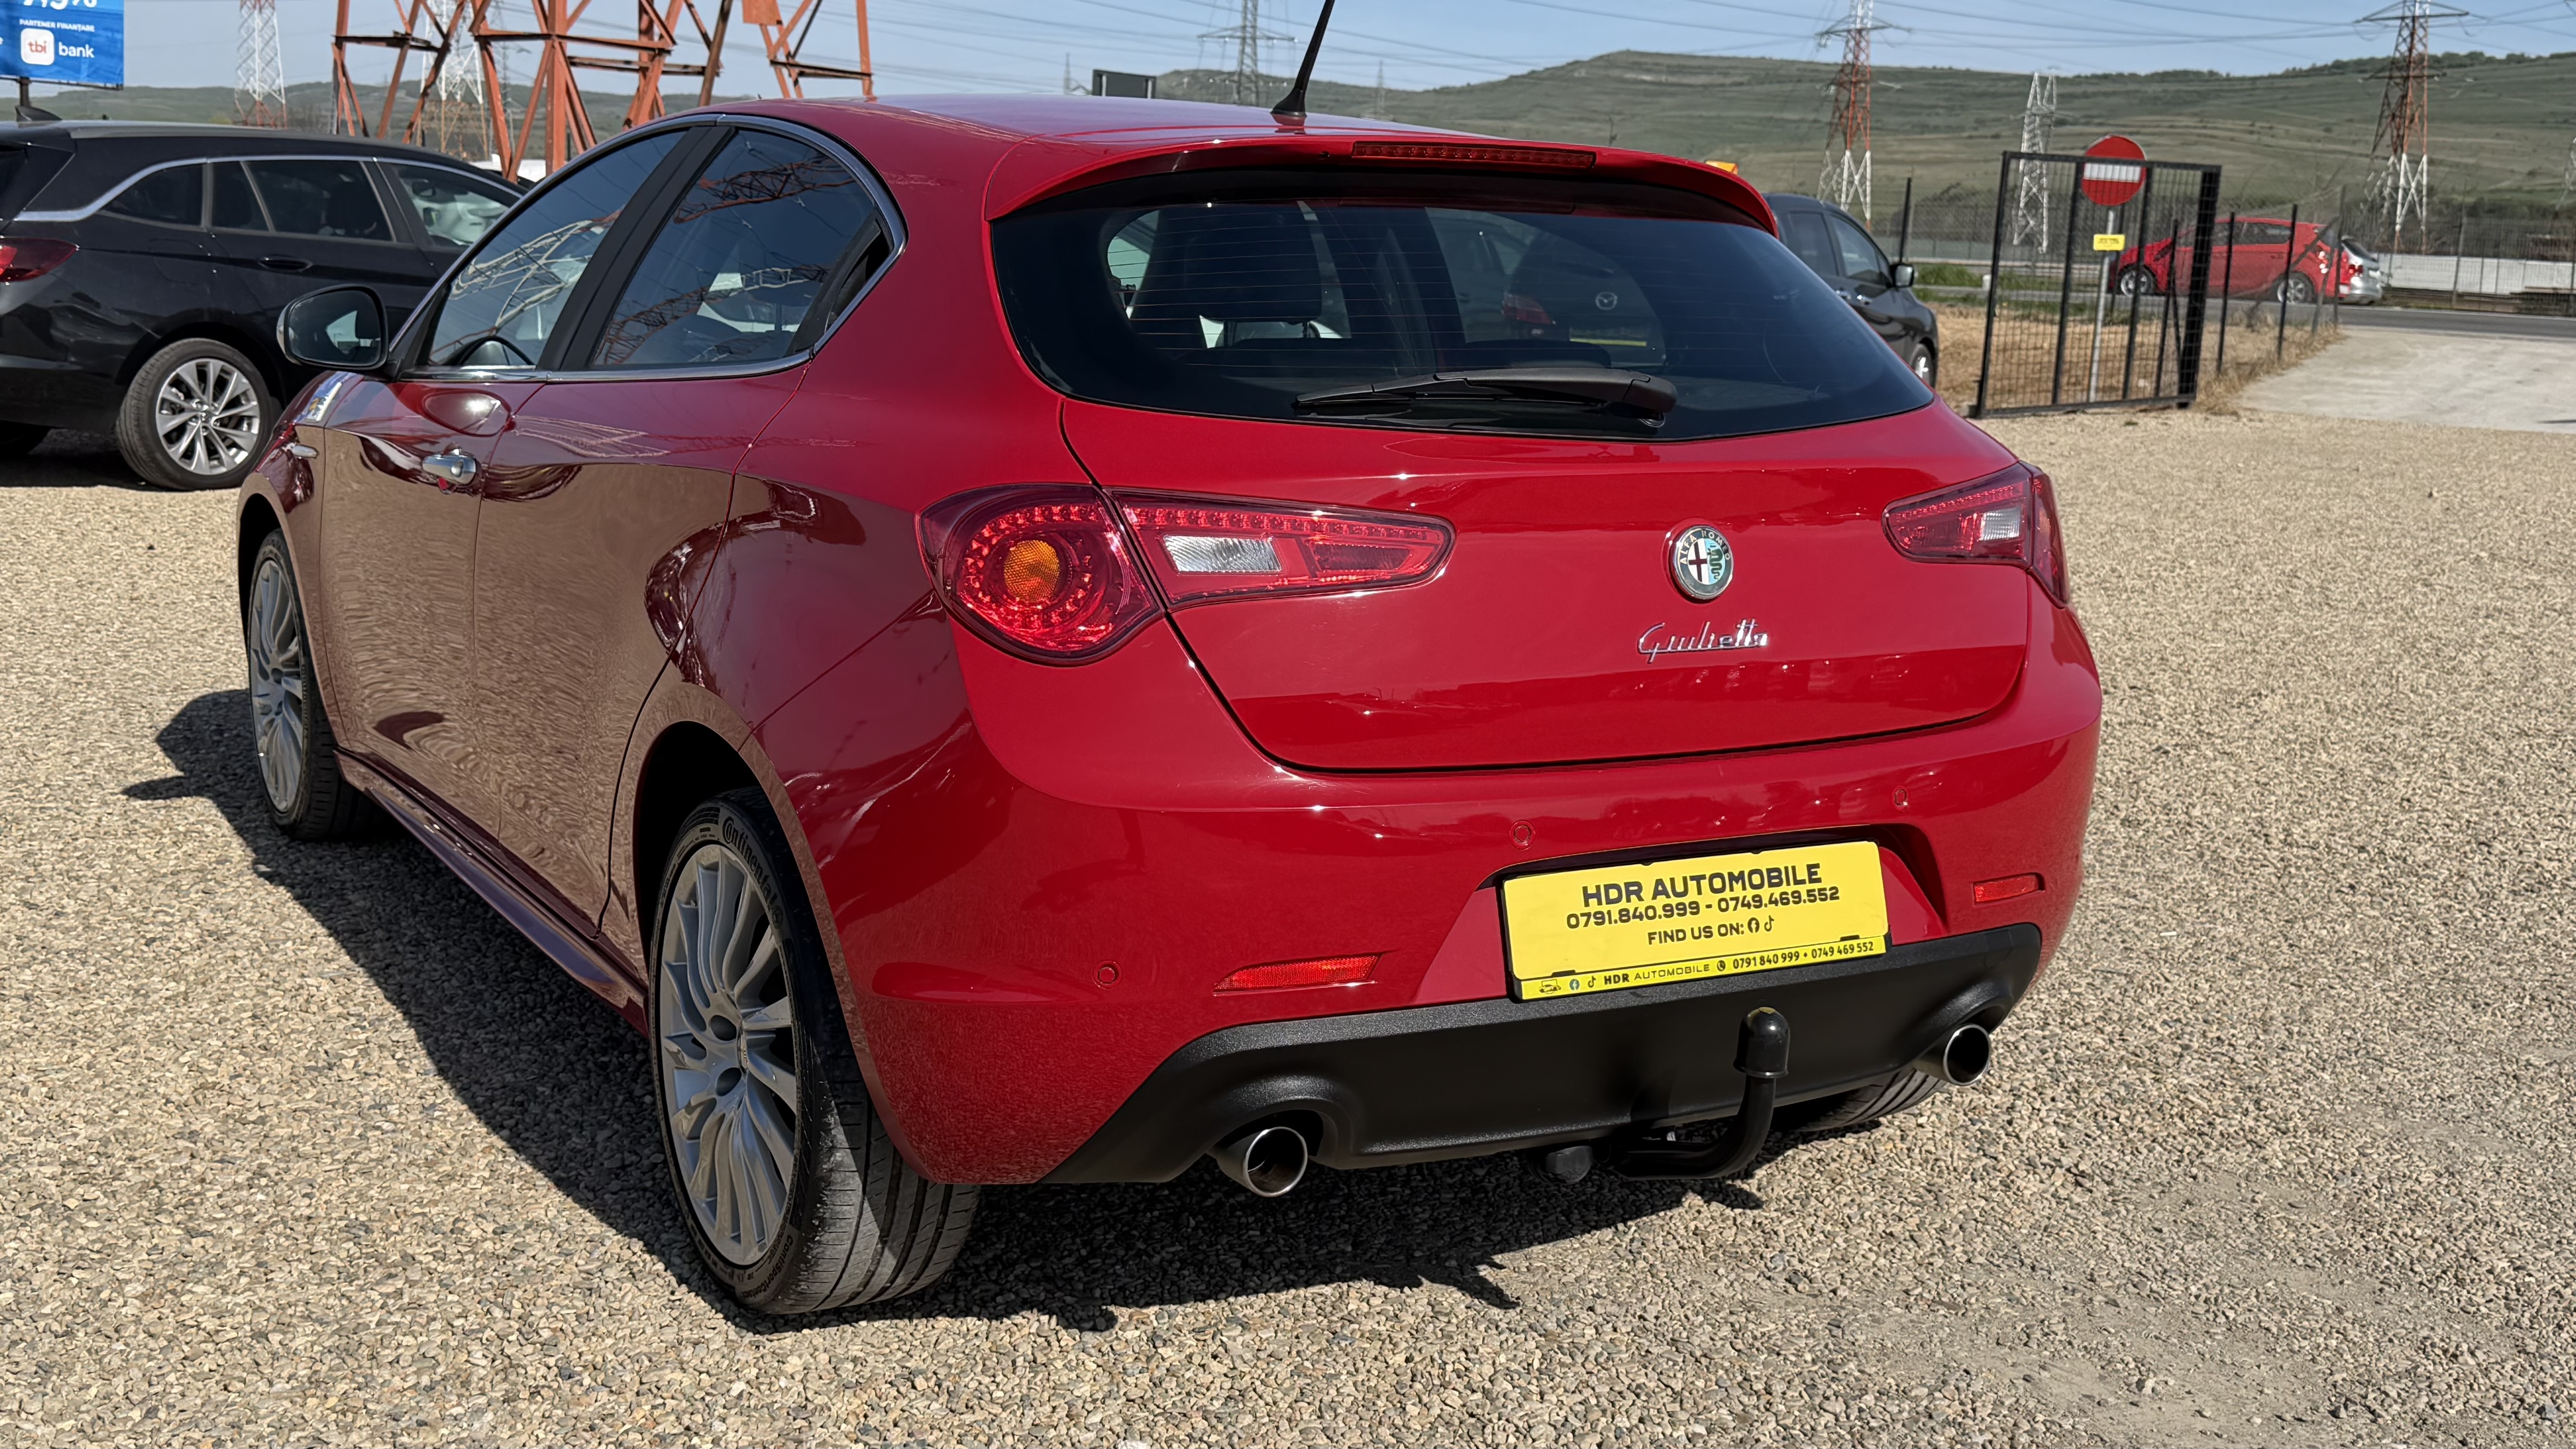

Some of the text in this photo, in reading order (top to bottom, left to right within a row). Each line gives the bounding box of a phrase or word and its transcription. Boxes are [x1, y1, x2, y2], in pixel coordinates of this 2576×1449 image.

[19, 19, 55, 28] PARTENER
[28, 41, 94, 58] tbi bank
[1680, 530, 1730, 564] ALFA ROMEO
[1637, 619, 1767, 663] Giulietta
[722, 816, 778, 912] Continental
[1582, 863, 1822, 907] HDR AUTOMOBILE
[1567, 901, 1700, 929] 0791.840.999
[1718, 886, 1840, 912] 0749.469.552
[1647, 922, 1744, 945] FIND US ON:
[1604, 973, 1630, 985] HDR
[1634, 964, 1711, 981] AUTOMOBILE
[1781, 951, 1799, 963] 999
[1811, 946, 1835, 958] 0749
[1837, 943, 1854, 955] 469
[1857, 941, 1874, 952] 552
